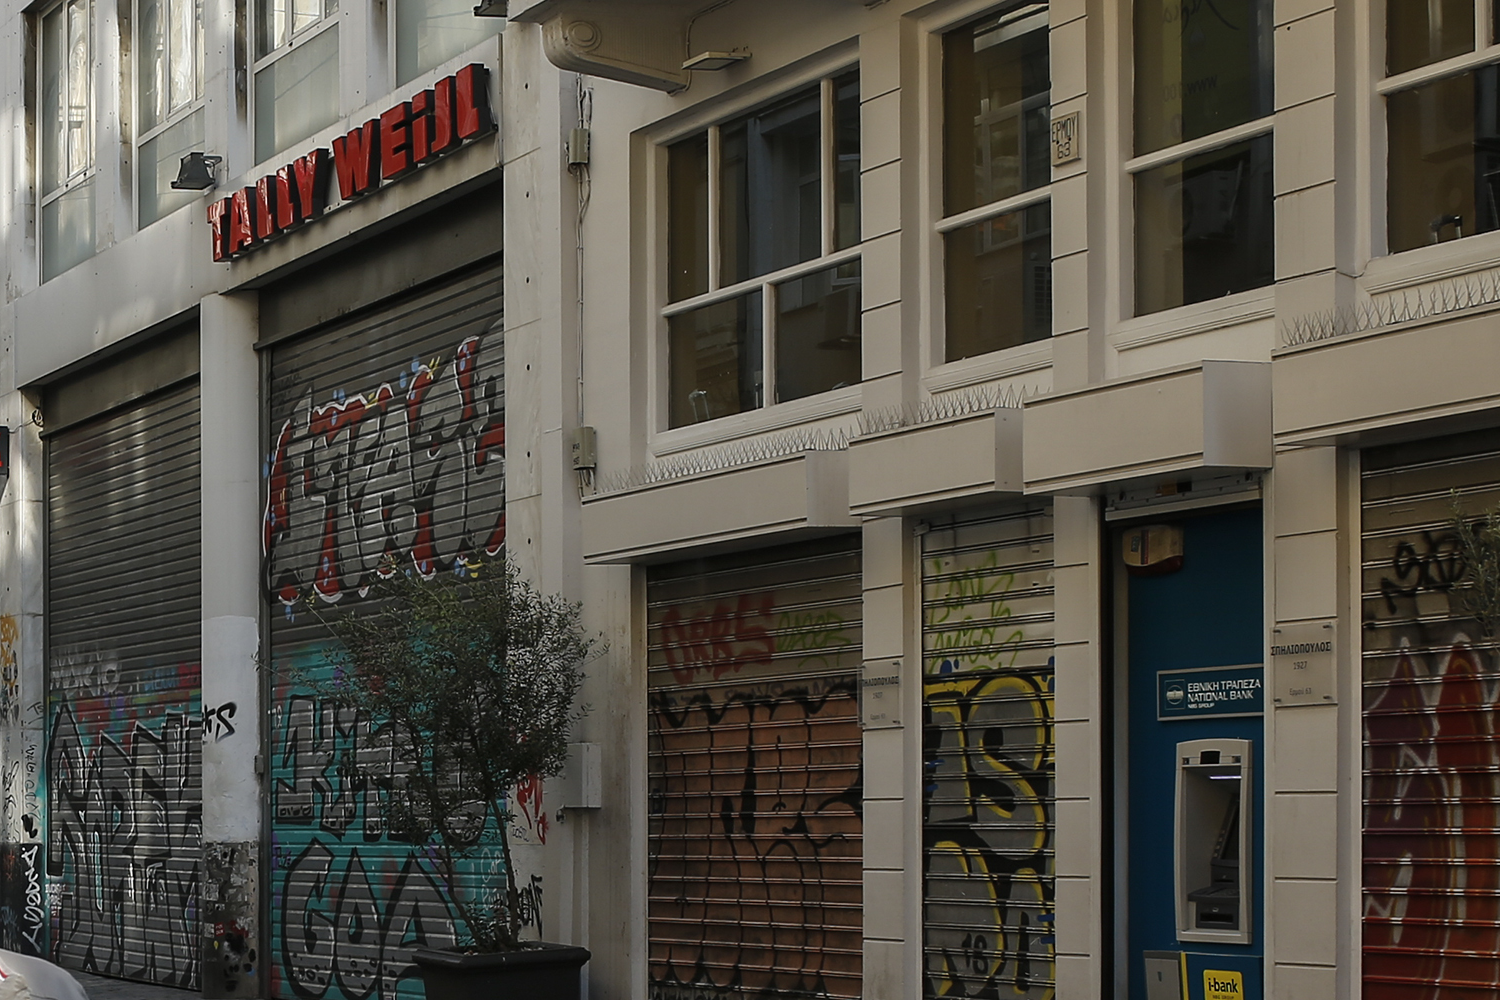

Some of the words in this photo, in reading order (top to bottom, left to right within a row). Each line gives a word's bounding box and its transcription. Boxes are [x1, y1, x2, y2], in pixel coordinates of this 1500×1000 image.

[1051, 116, 1076, 143] ΕΡΜΟΥ
[1057, 142, 1071, 159] 63
[206, 147, 329, 263] TALLY
[1270, 641, 1332, 657] ΣΠΗΛΙΟΠΟΥΛΟΣ
[1220, 678, 1262, 690] ΤΡΑΠΕΖΑ
[1187, 691, 1229, 703] NATIONAL
[1229, 690, 1254, 701] BANK
[1207, 977, 1239, 994] i-bank
